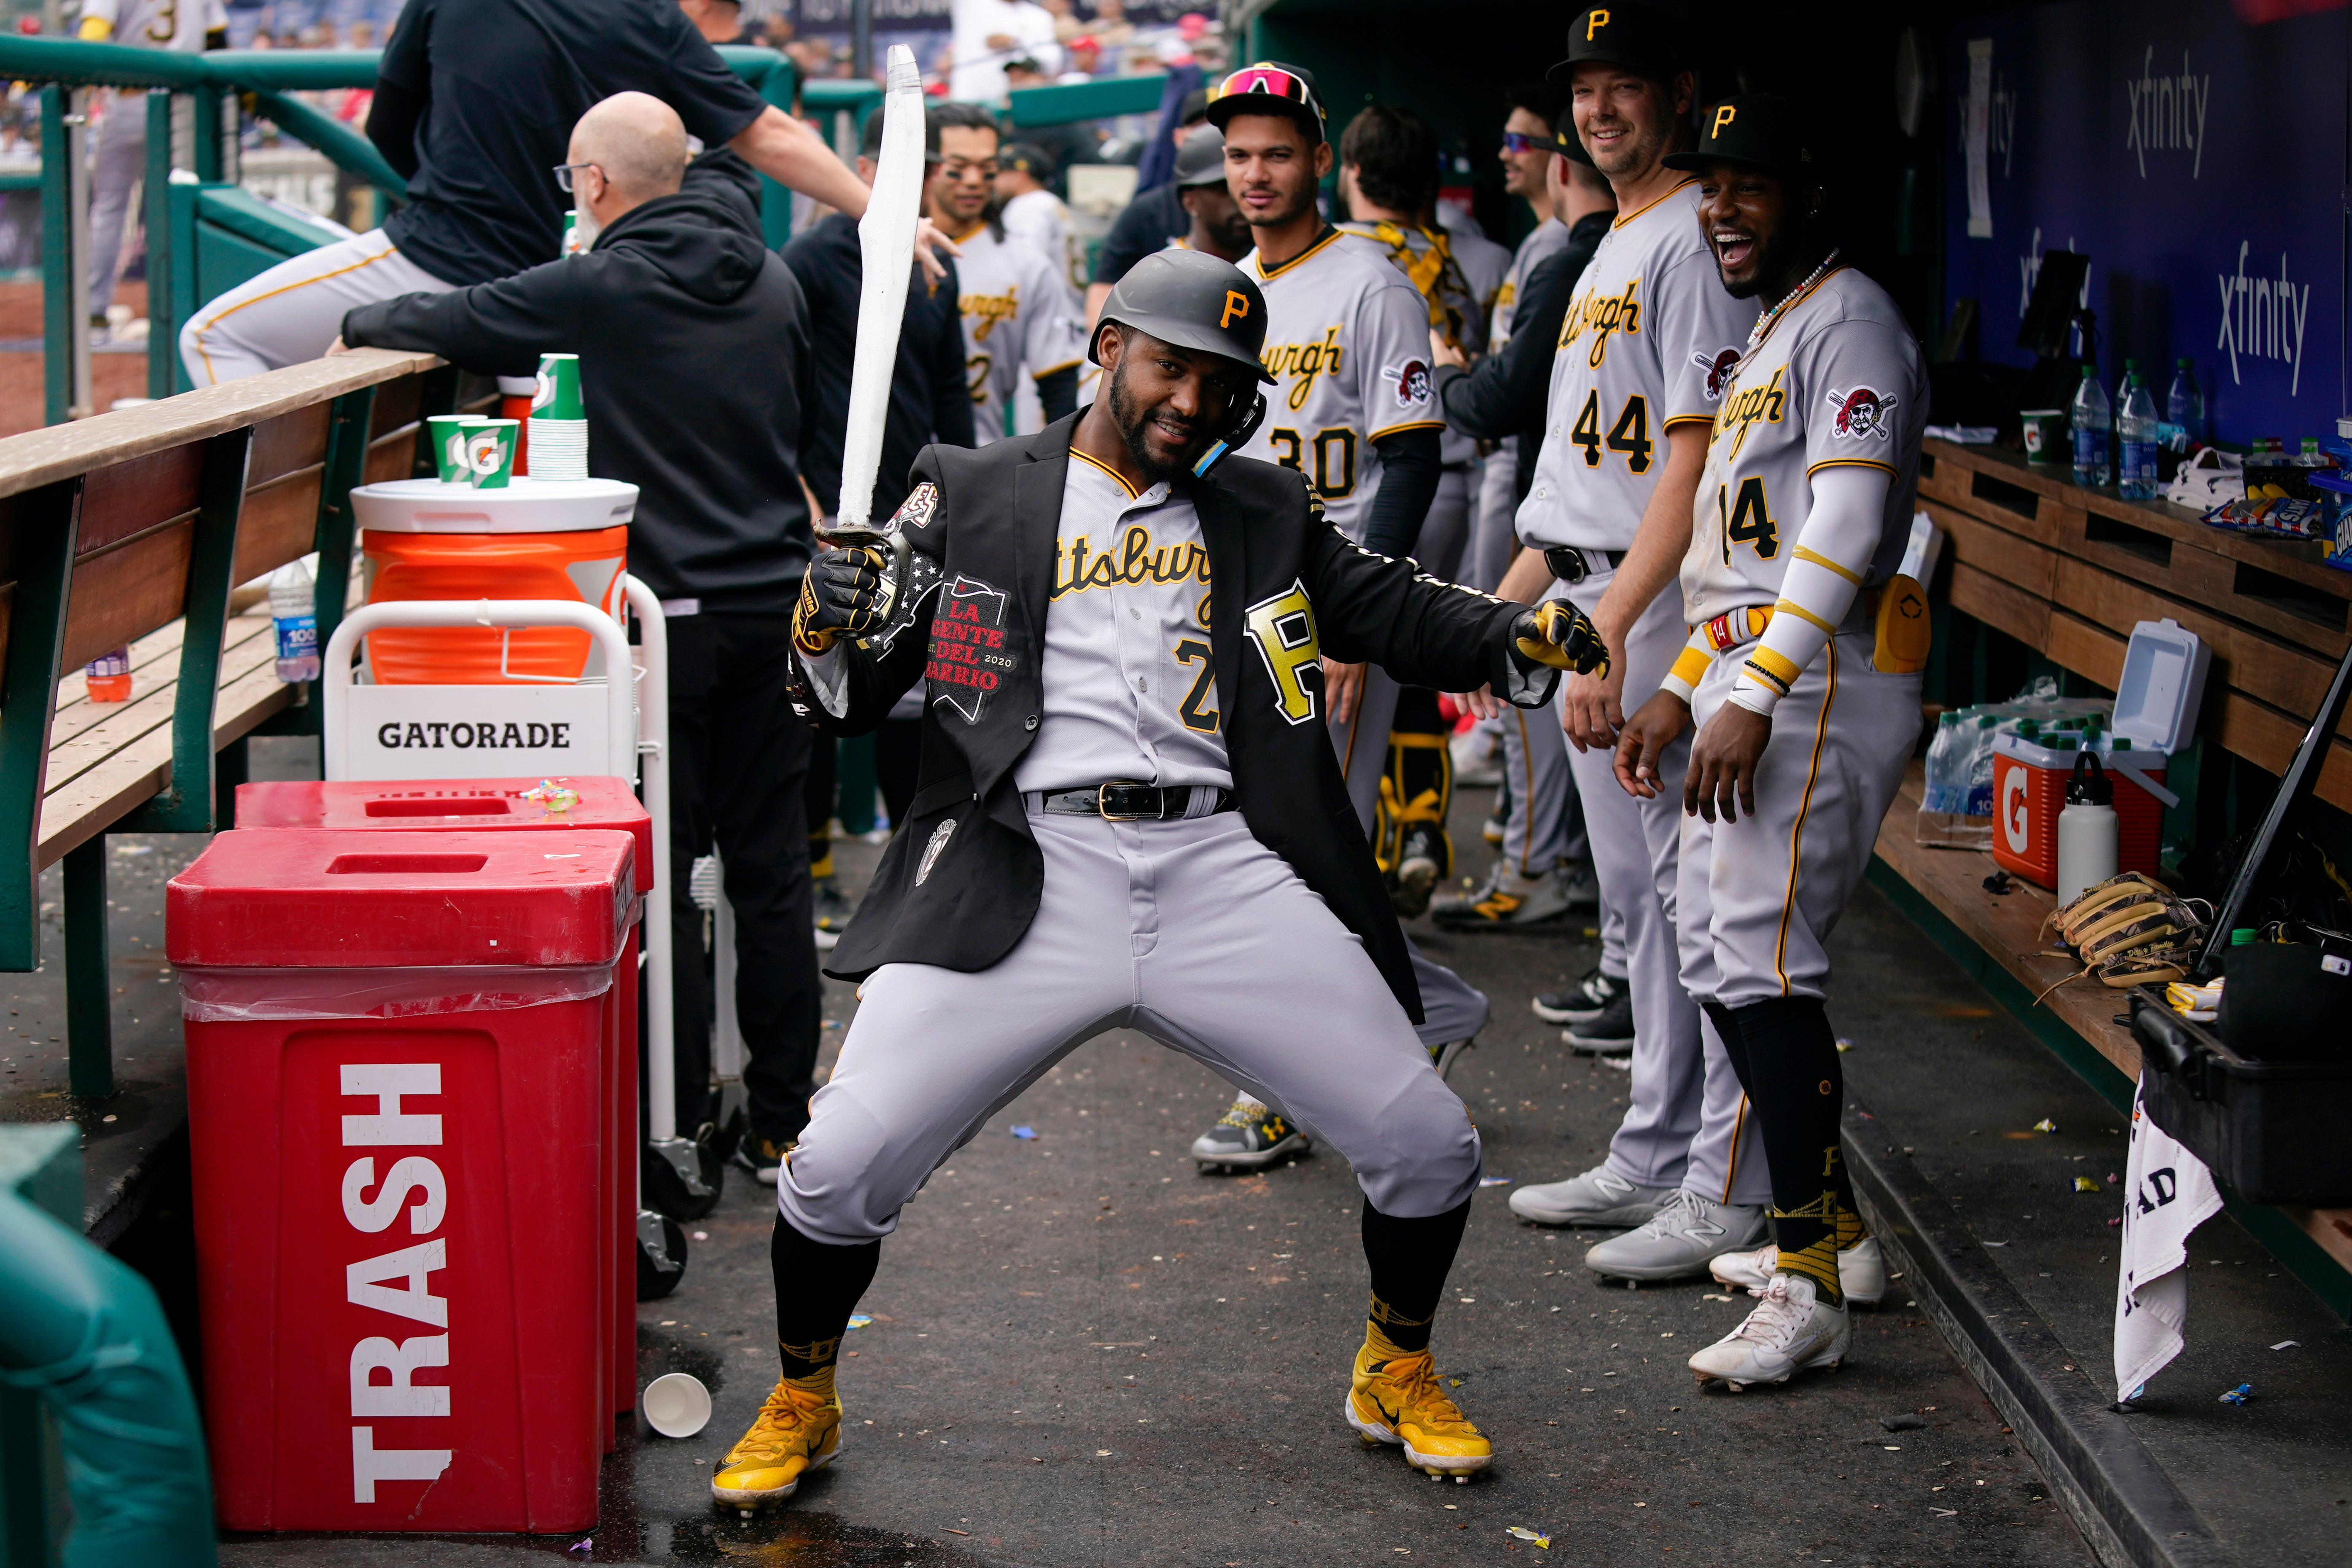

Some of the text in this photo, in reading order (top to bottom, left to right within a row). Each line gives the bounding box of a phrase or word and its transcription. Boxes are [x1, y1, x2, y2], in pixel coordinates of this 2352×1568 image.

[1587, 9, 1610, 41] P
[1712, 105, 1737, 139] P
[2127, 44, 2209, 180] xfinity
[1220, 290, 1250, 328] P
[2218, 239, 2309, 397] xfinity
[1570, 387, 1654, 475] 44
[468, 436, 500, 475] G
[1269, 427, 1357, 500] 30
[1718, 475, 1781, 568] 14
[949, 600, 980, 623] LA
[1713, 620, 1726, 641] 14
[931, 619, 1004, 648] GENTE
[935, 640, 979, 665] DEL
[1244, 577, 1323, 726] P
[925, 660, 998, 690] ARRIO
[985, 654, 1012, 667] 2020
[1172, 637, 1220, 734] 2
[378, 722, 571, 748] GATORADE
[2003, 765, 2028, 854] G
[340, 1063, 452, 1503] TRASH
